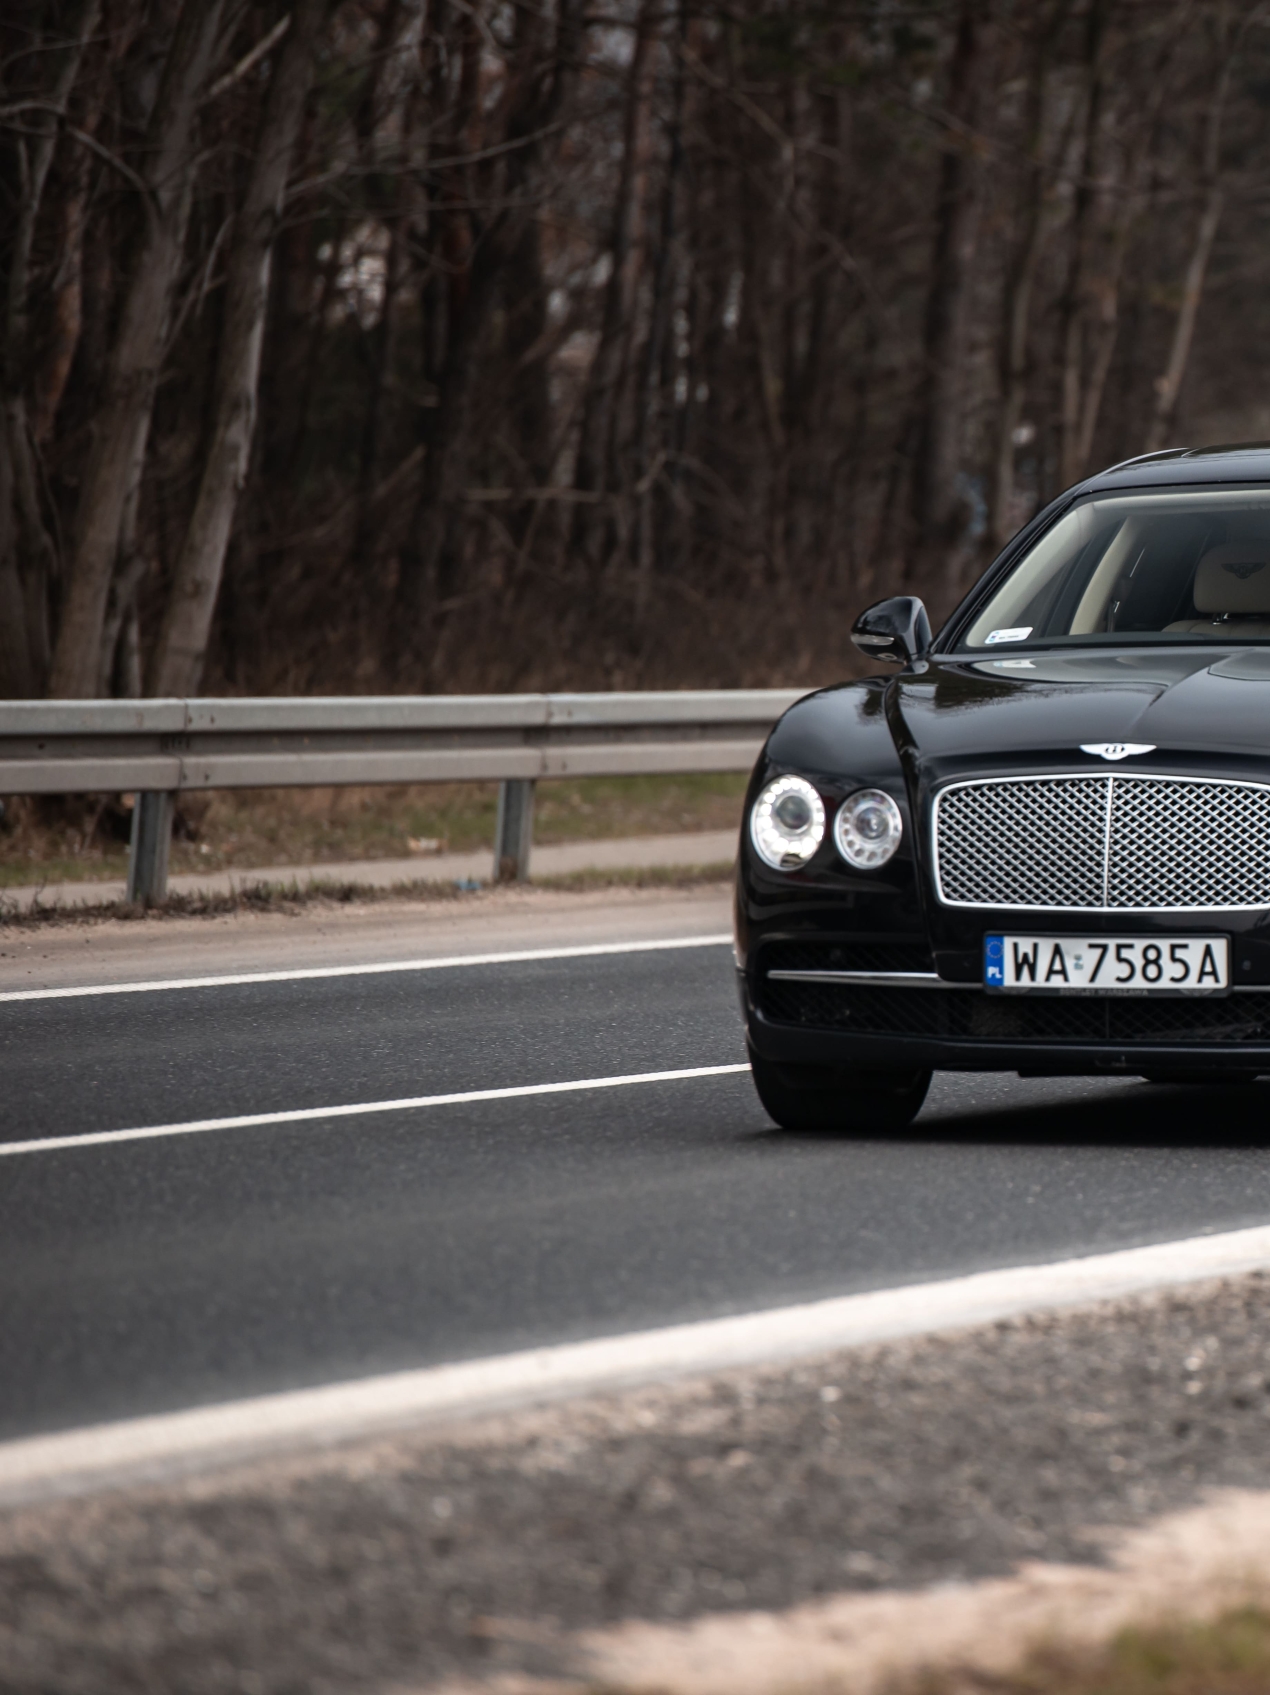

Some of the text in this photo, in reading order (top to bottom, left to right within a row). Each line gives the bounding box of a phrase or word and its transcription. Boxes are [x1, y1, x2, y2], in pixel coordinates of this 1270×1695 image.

[987, 966, 1002, 978] PL
[1013, 942, 1220, 983] WA 7585A
